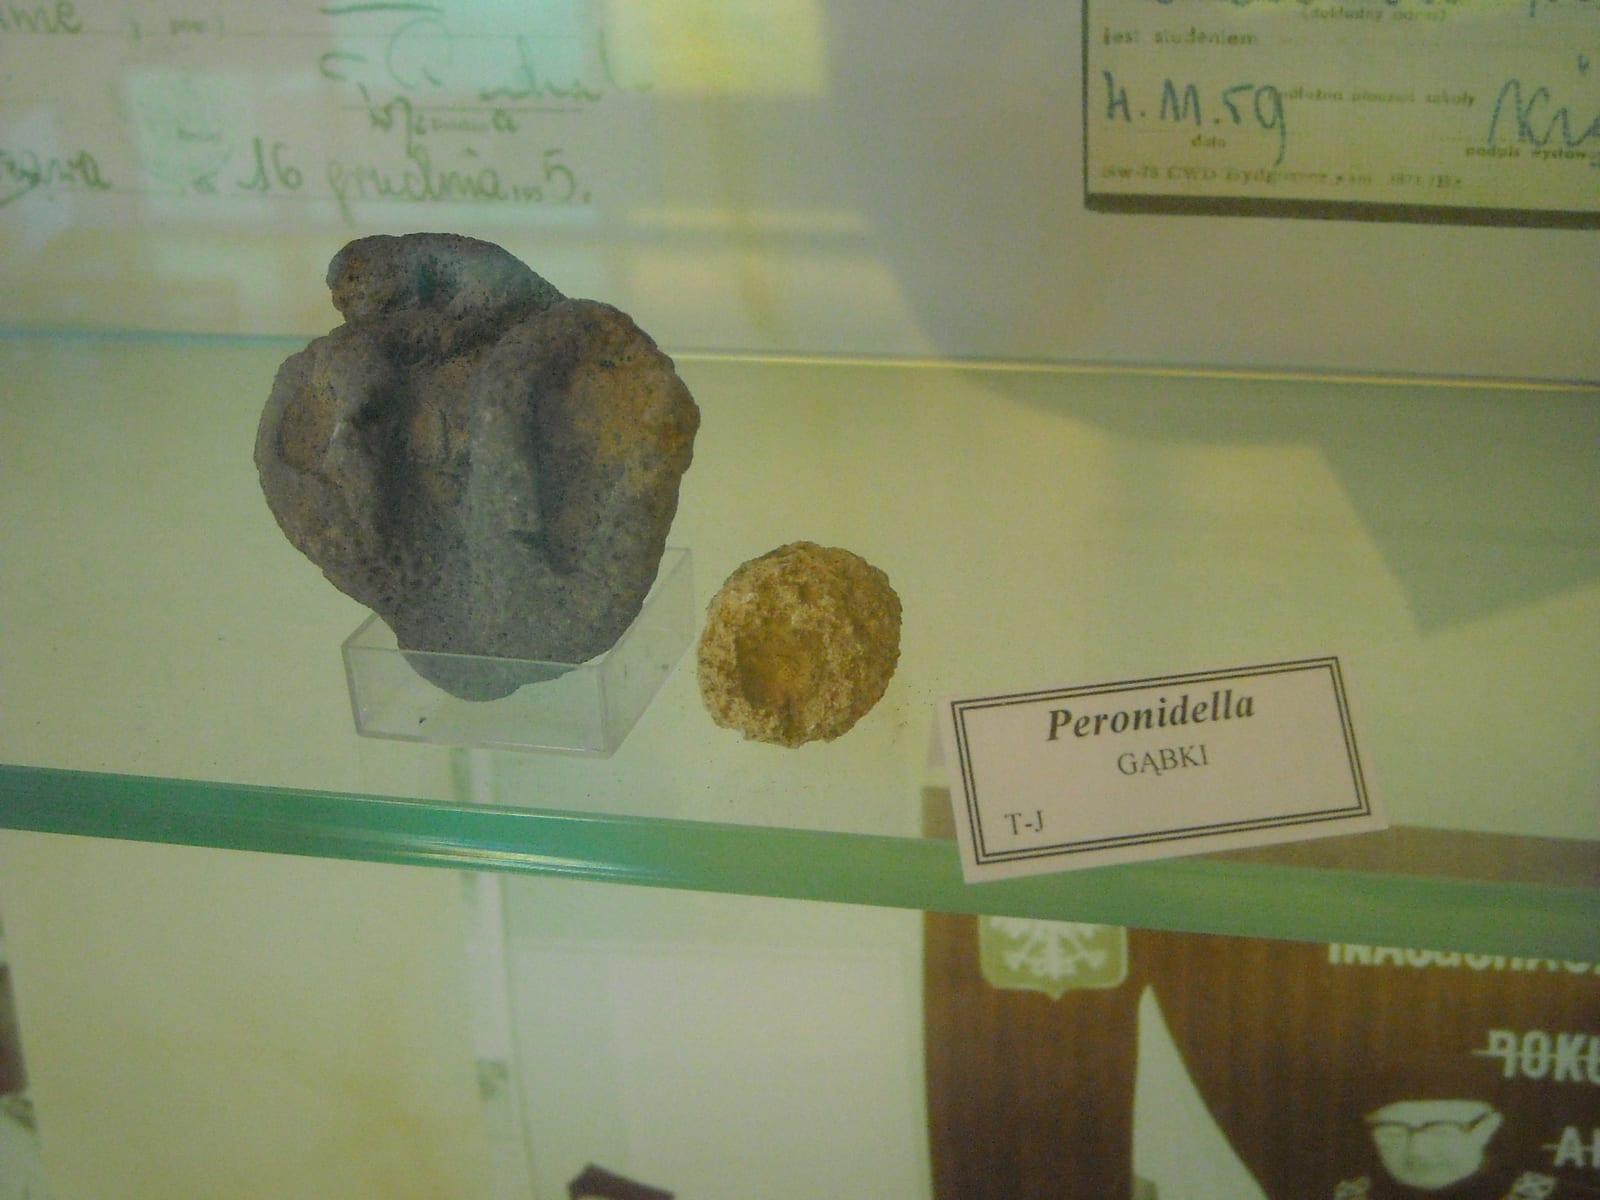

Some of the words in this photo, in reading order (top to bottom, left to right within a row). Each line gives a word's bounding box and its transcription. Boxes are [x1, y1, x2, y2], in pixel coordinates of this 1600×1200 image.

[1047, 689, 1256, 741] Peronidella
[1117, 744, 1209, 776] GĄBKI
[1004, 810, 1044, 836] T-J
